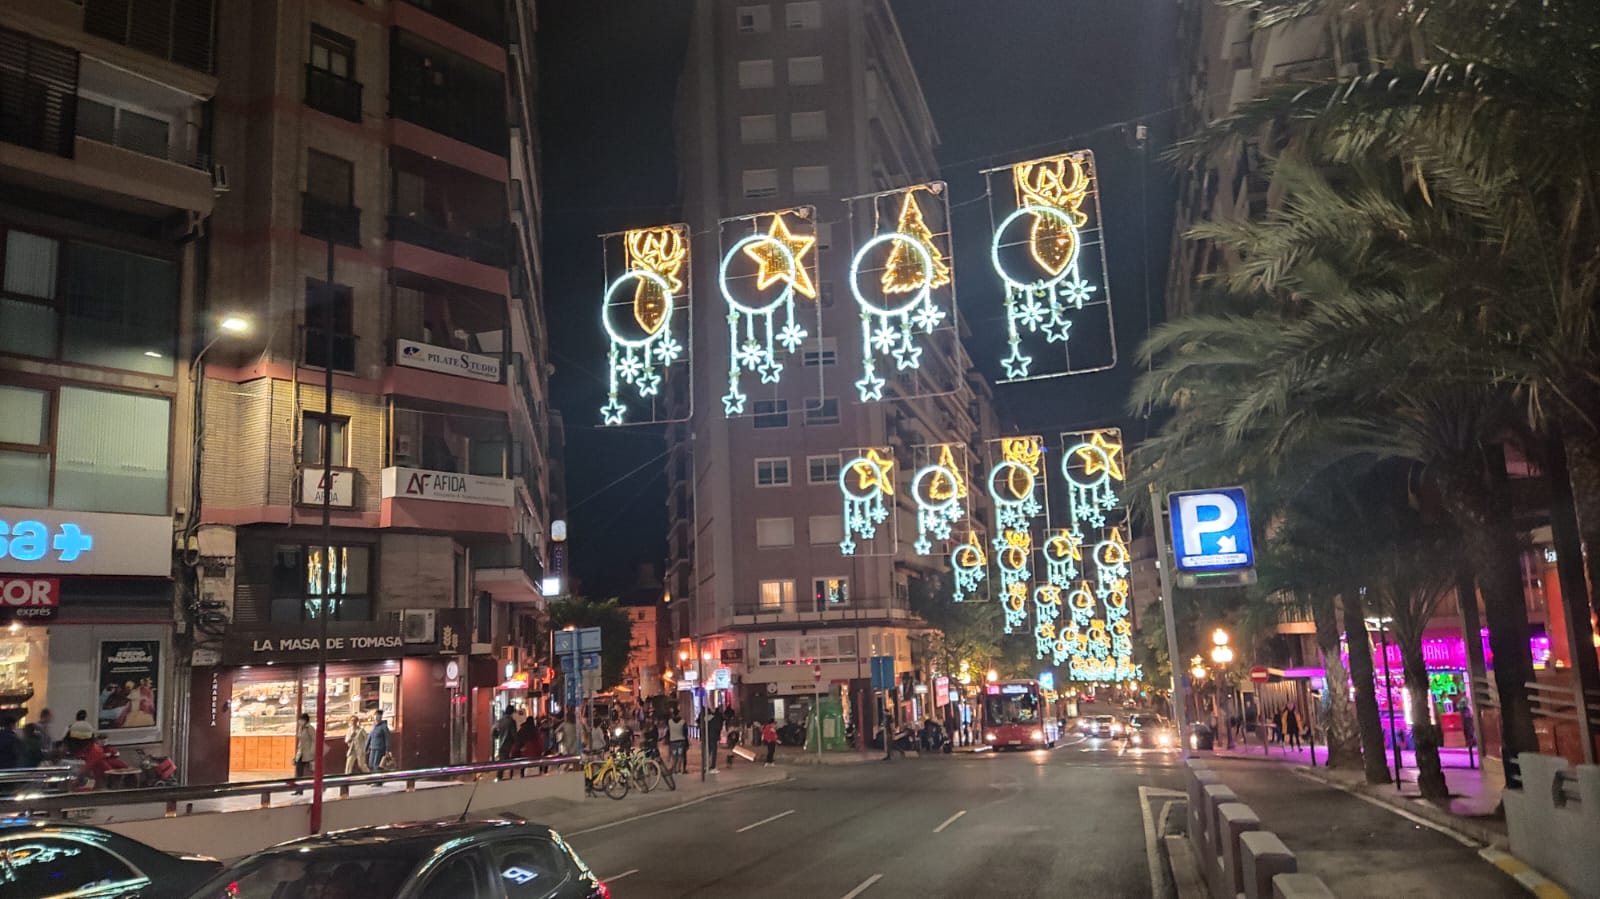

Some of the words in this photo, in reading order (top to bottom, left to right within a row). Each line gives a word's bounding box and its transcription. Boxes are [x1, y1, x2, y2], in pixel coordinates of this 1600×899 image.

[433, 474, 467, 493] AFIDA
[314, 491, 338, 503] AFDA
[1178, 493, 1238, 556] P
[0, 519, 48, 561] a
[0, 579, 52, 605] OR
[253, 639, 273, 652] LA
[279, 637, 321, 651] MASA
[326, 637, 344, 649] DE
[350, 635, 403, 648] TOMASA
